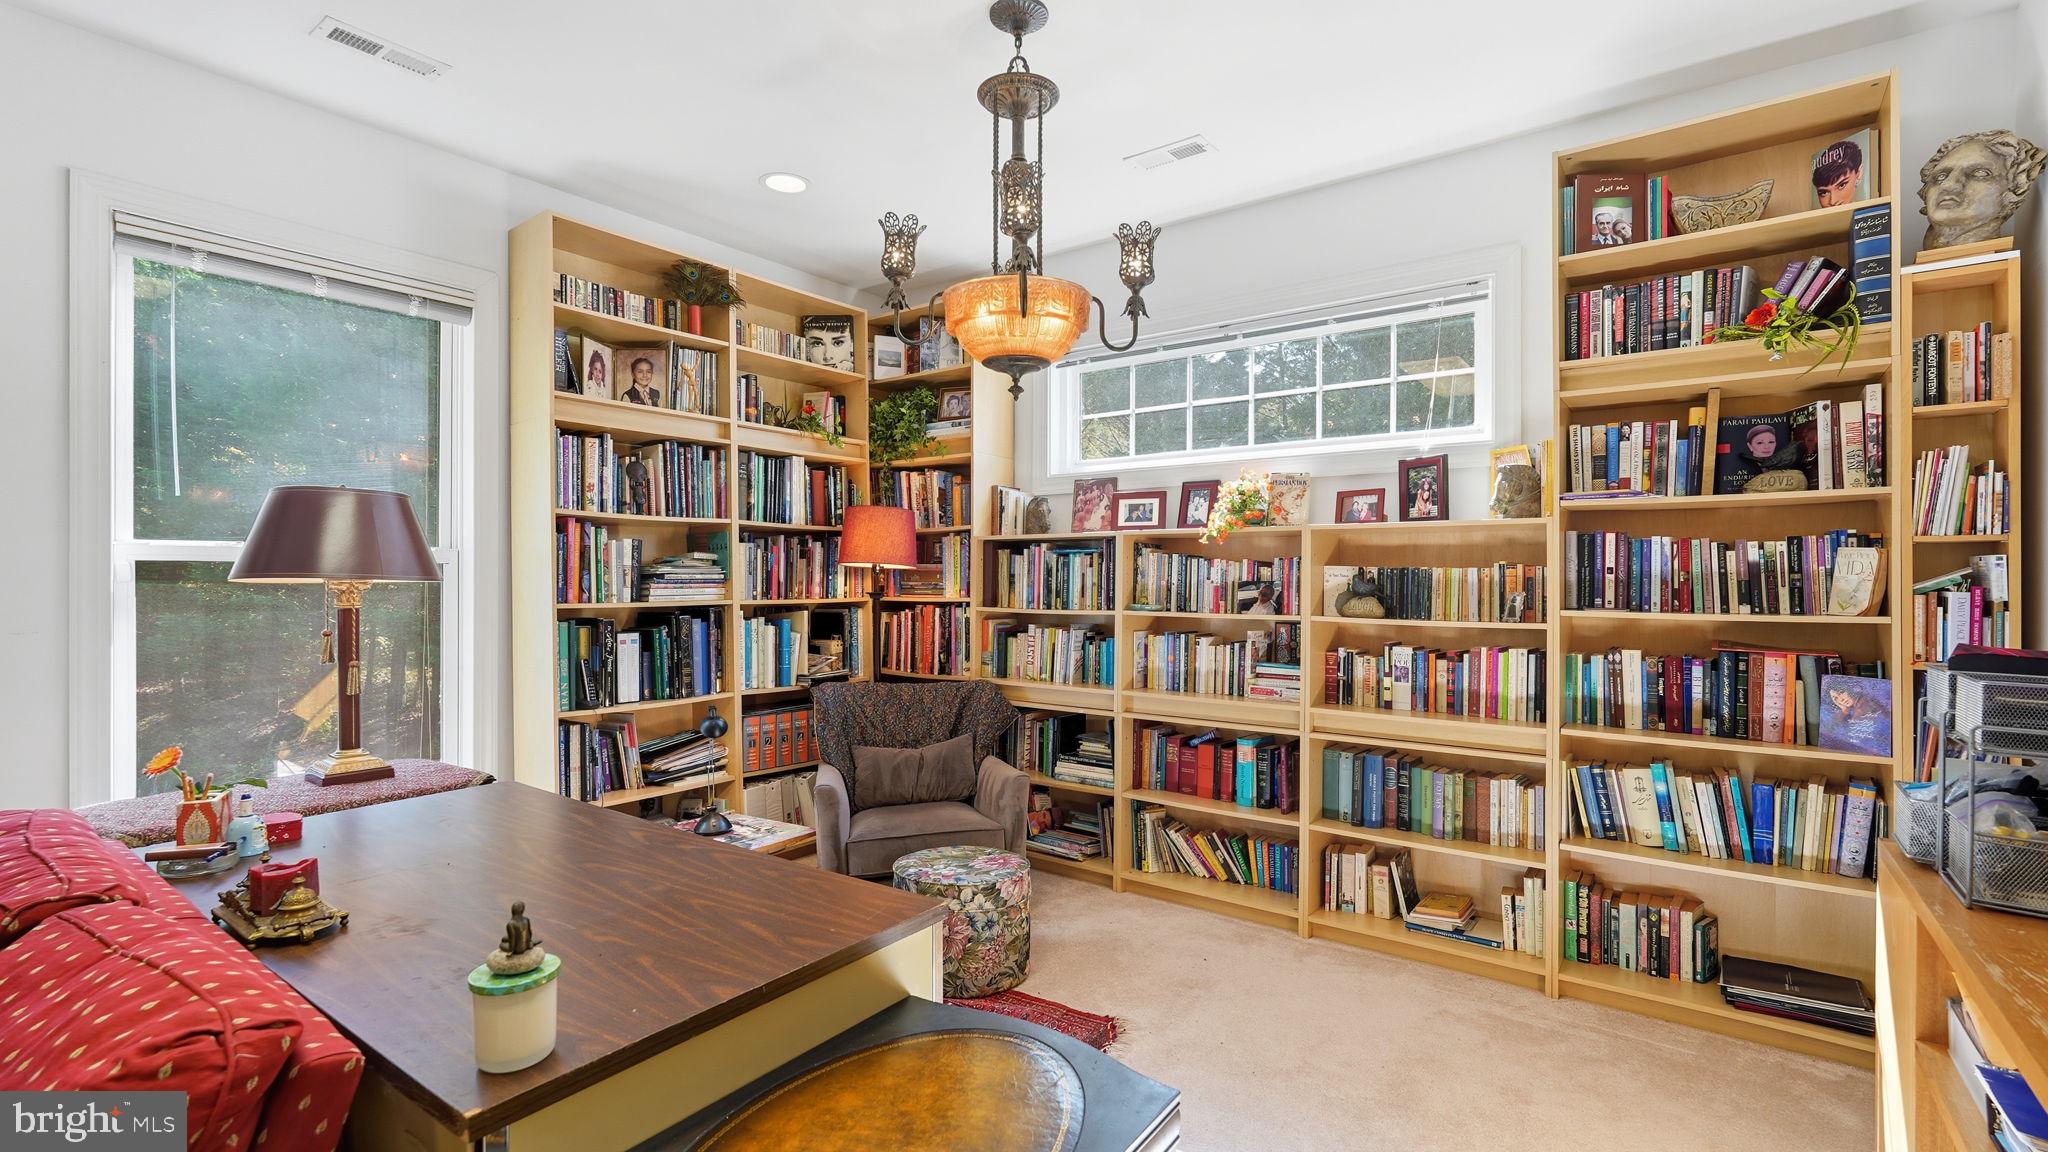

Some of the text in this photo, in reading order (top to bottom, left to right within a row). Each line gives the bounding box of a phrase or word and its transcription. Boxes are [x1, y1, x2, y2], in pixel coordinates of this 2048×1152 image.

[1811, 145, 1845, 171] audrey
[1629, 301, 1637, 316] THE
[1928, 341, 1936, 367] MARGOT
[1722, 416, 1788, 427] FARAH PAHLAVI
[1760, 475, 1794, 488] LOVE
[1026, 634, 1035, 665] FIASCO
[559, 682, 569, 710] IRAN
[765, 736, 772, 745] 2
[1435, 780, 1443, 809] POEMS
